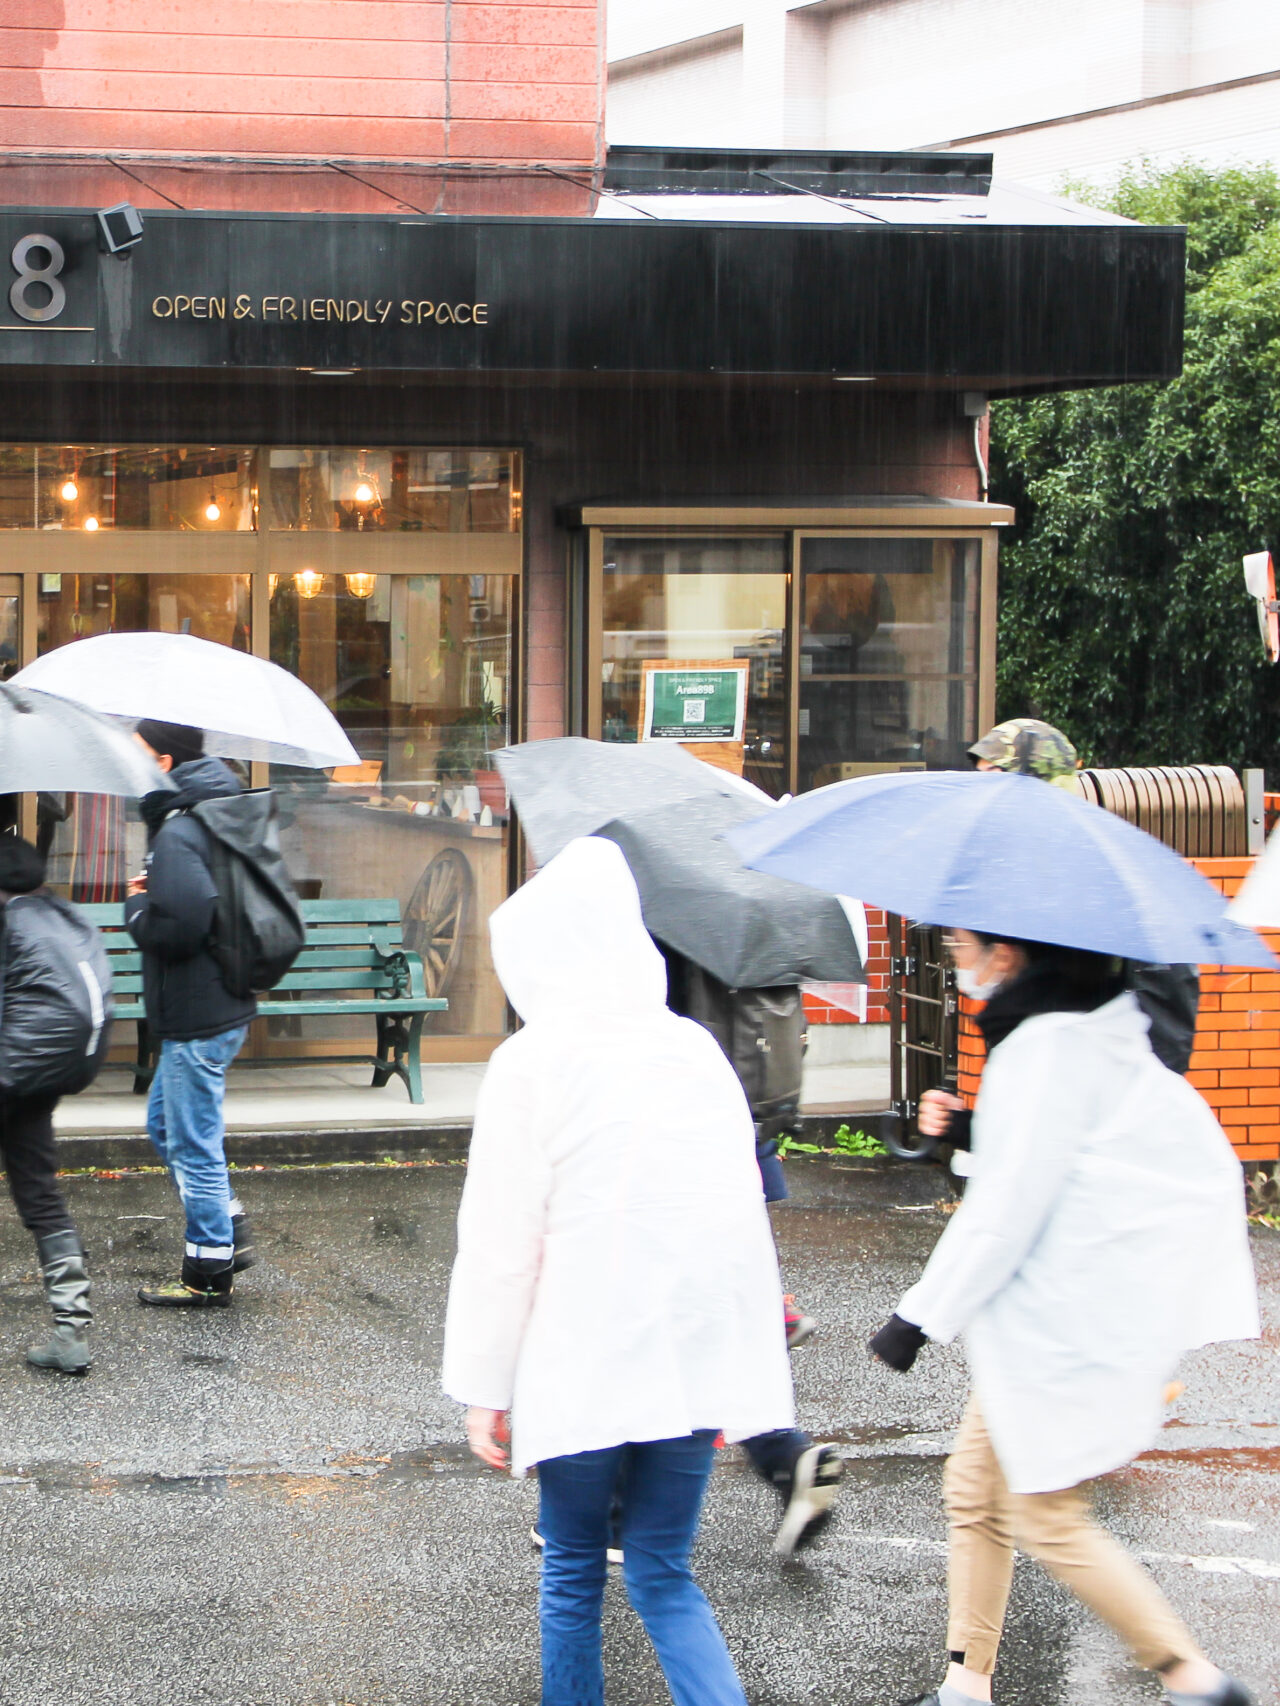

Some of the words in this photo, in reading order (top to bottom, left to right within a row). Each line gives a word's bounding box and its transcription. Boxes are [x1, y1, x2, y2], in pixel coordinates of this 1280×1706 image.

[152, 296, 225, 319] OPEN
[233, 294, 256, 319] &
[262, 296, 392, 324] FRIENDLY
[400, 300, 488, 325] SPACE
[675, 684, 715, 695] Area898
